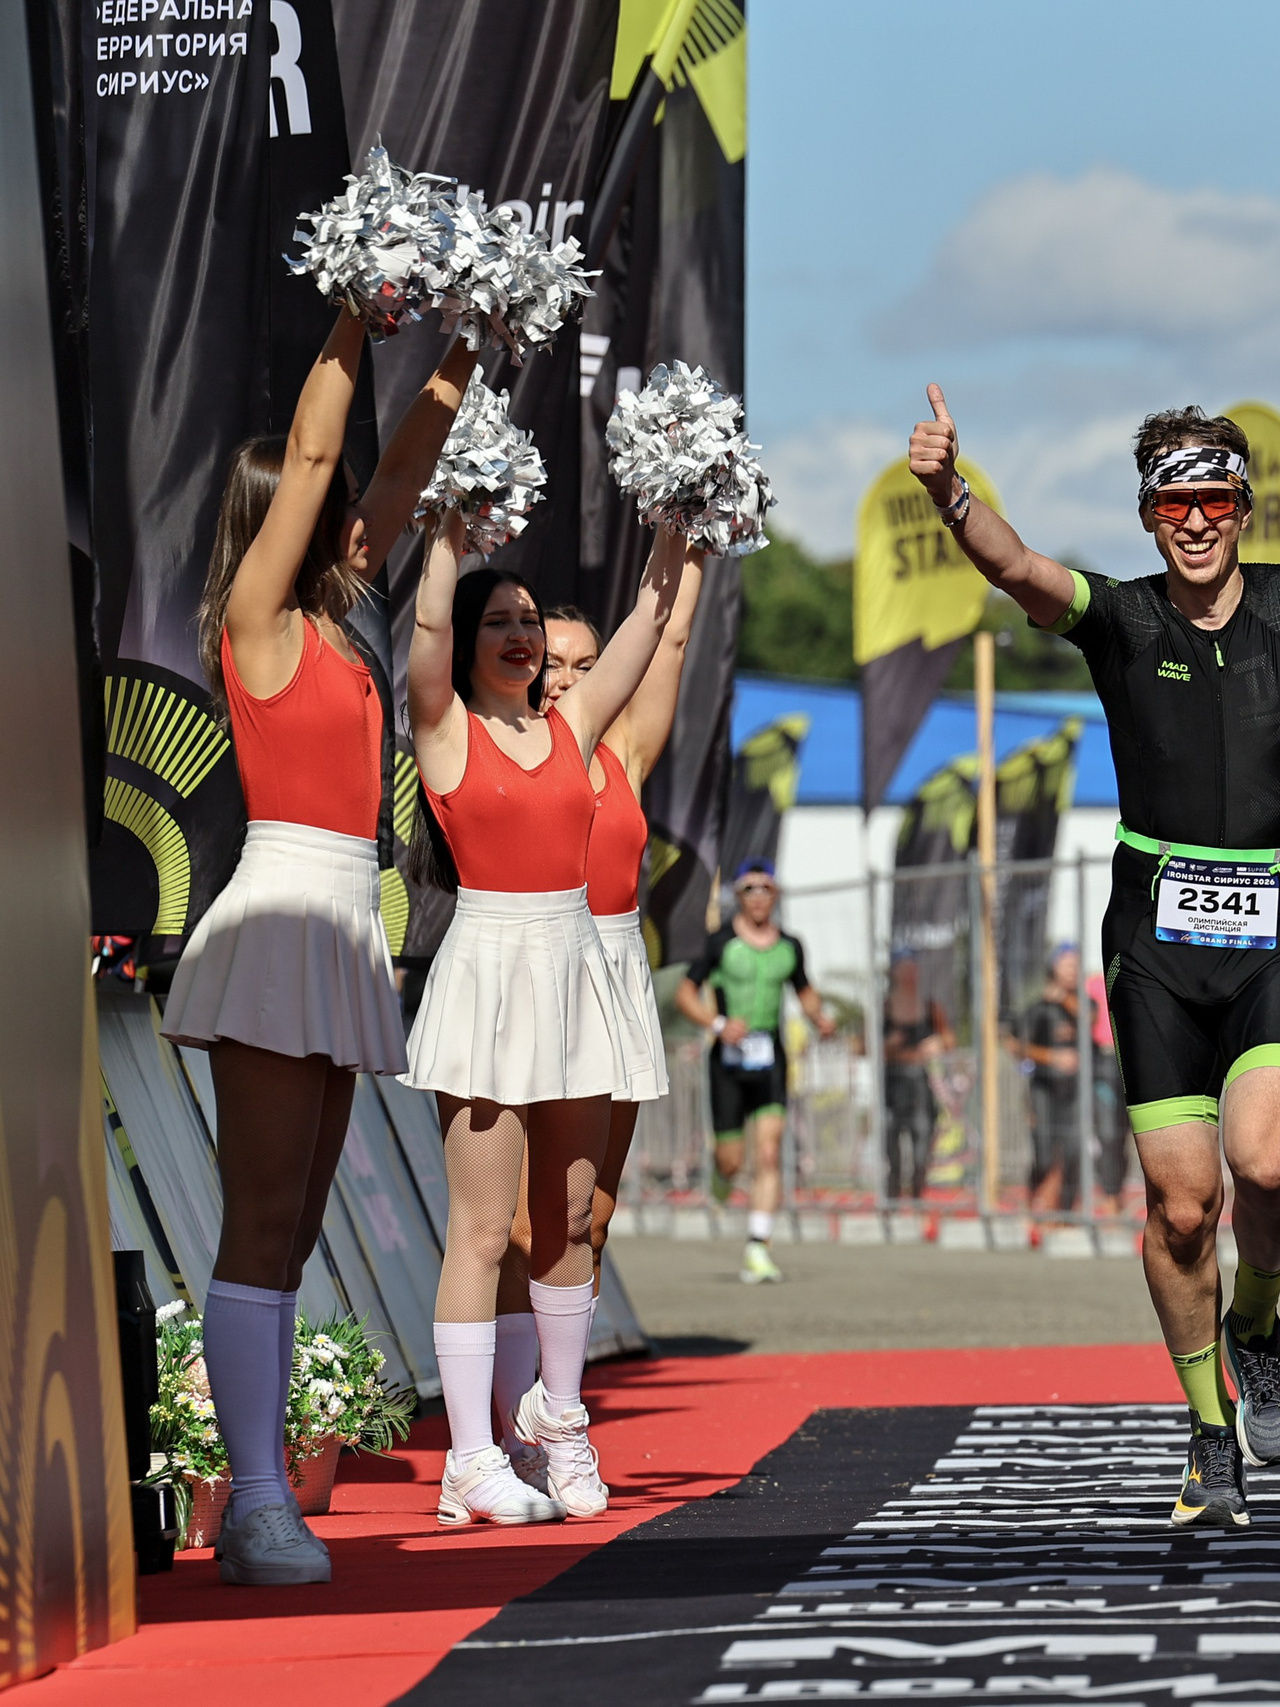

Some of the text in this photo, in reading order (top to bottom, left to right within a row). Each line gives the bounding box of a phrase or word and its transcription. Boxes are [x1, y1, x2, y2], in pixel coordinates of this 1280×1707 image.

[96, 0, 253, 26] ЕДЕРАЛЬНА
[97, 32, 248, 60] ЕРРИТОРИЯ
[96, 69, 210, 97] СИРИУС»
[894, 531, 970, 581] STA
[1161, 660, 1188, 673] MAD
[1157, 668, 1192, 682] WAVE
[1167, 870, 1211, 883] IRONSTAR
[1214, 876, 1251, 885] СИРИУС
[1253, 878, 1276, 886] 2026
[1178, 887, 1260, 916] 2341
[1187, 916, 1248, 927] ОЛИМПИЙСКАЯ
[1193, 923, 1242, 933] ДИСТАНЦИЯ
[1200, 936, 1227, 945] GRAND
[1228, 938, 1253, 946] FINAL
